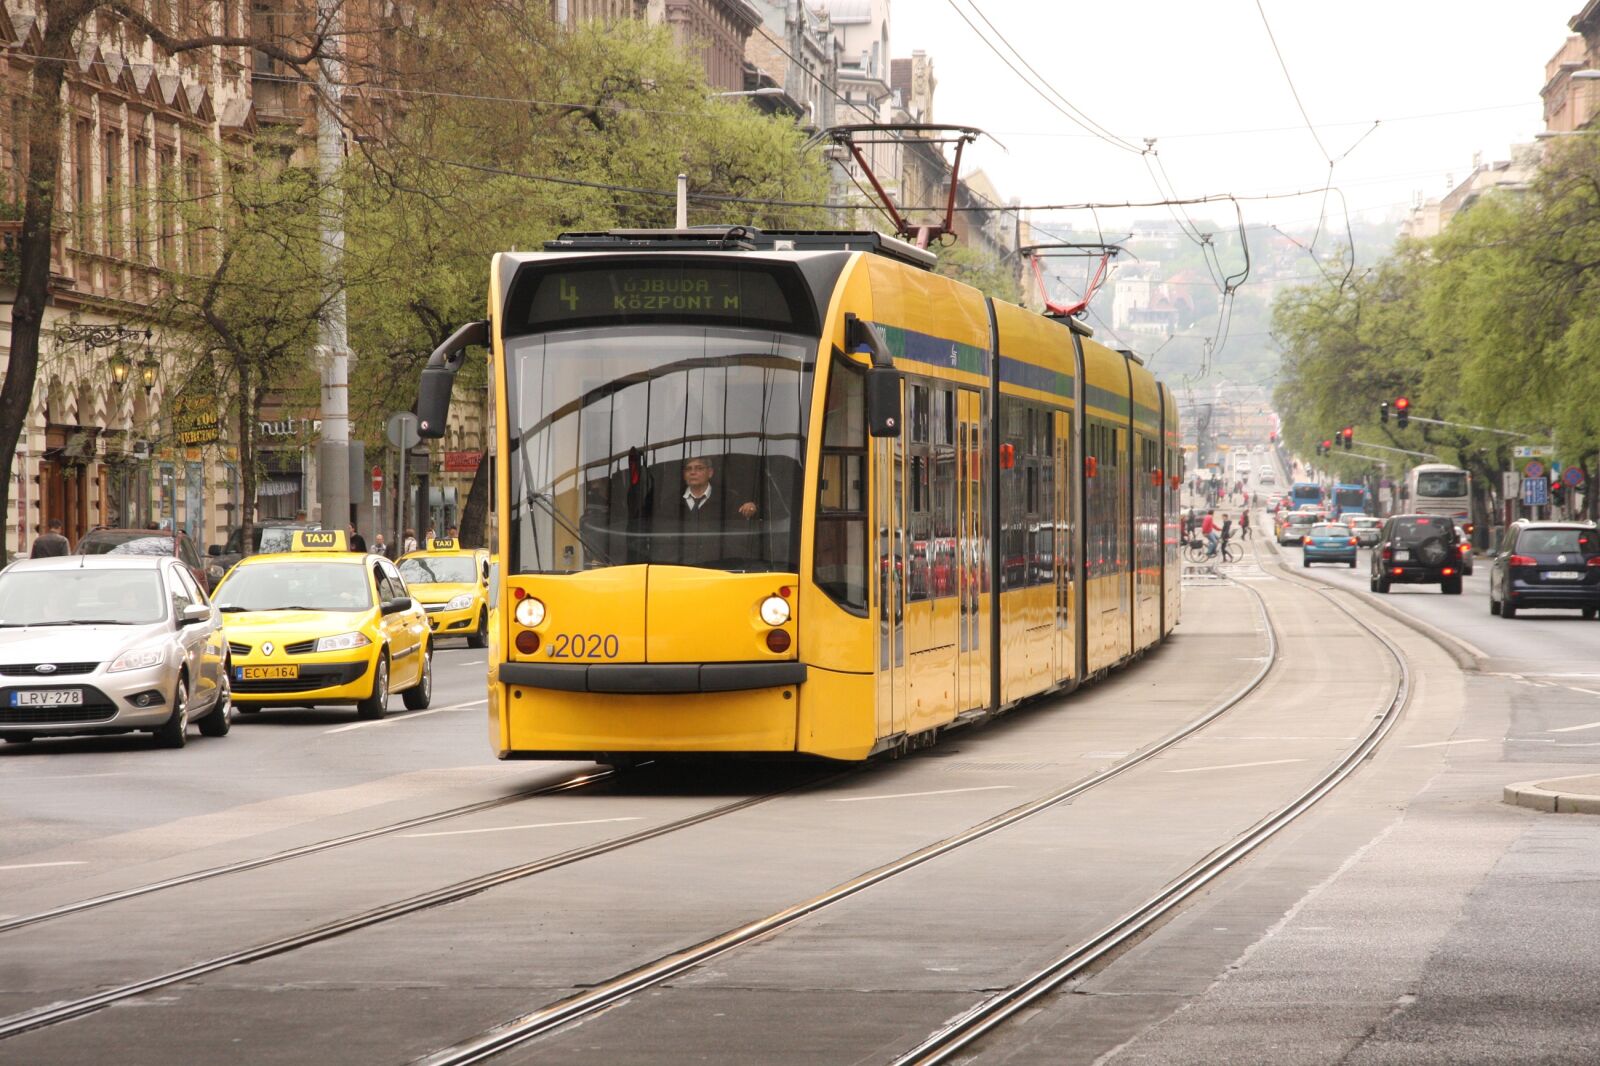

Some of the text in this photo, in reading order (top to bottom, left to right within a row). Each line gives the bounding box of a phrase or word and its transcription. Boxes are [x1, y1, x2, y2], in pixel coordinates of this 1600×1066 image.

[559, 274, 579, 311] 4
[723, 295, 739, 310] M
[178, 428, 218, 443] IERCING
[305, 533, 333, 543] TAXI
[435, 539, 452, 547] TAXI
[555, 633, 619, 658] 2020
[20, 690, 80, 705] LRV-278
